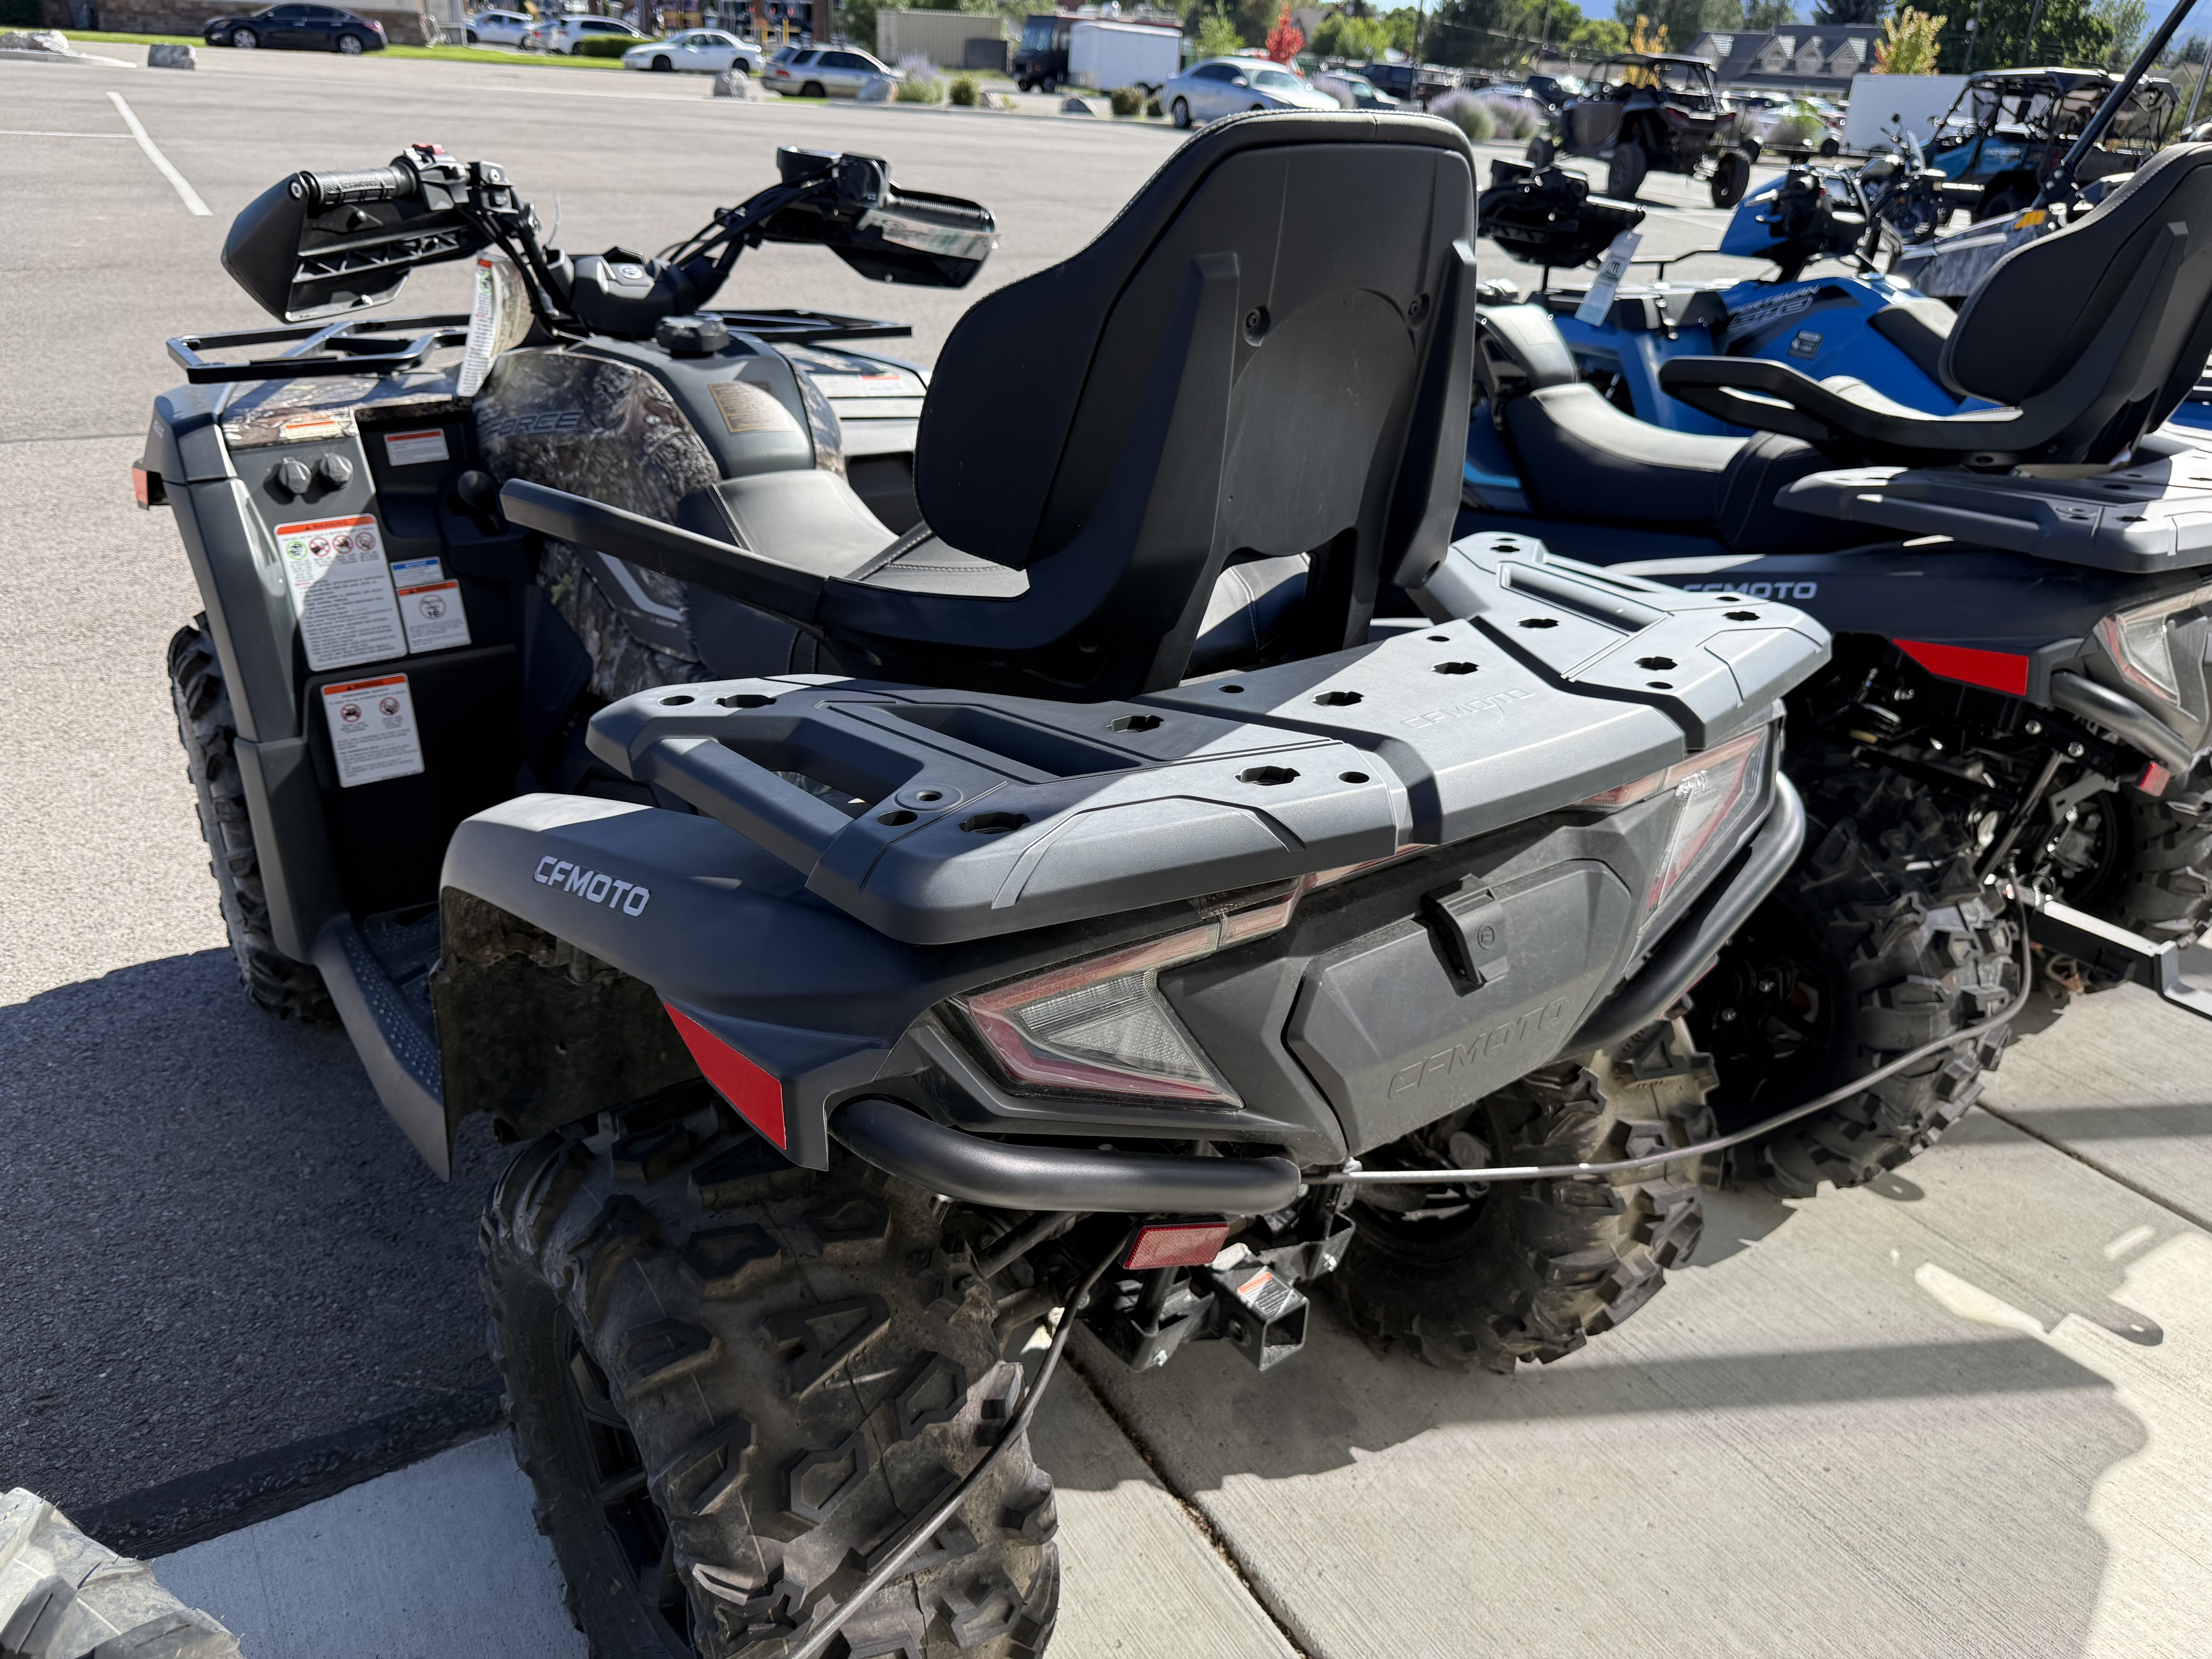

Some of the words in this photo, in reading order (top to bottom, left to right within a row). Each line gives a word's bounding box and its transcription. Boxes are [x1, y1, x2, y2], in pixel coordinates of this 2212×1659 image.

[1400, 689, 1535, 729] CFMOTO
[534, 855, 650, 917] CFMOTO
[1388, 996, 1566, 1099] CFMOTO
